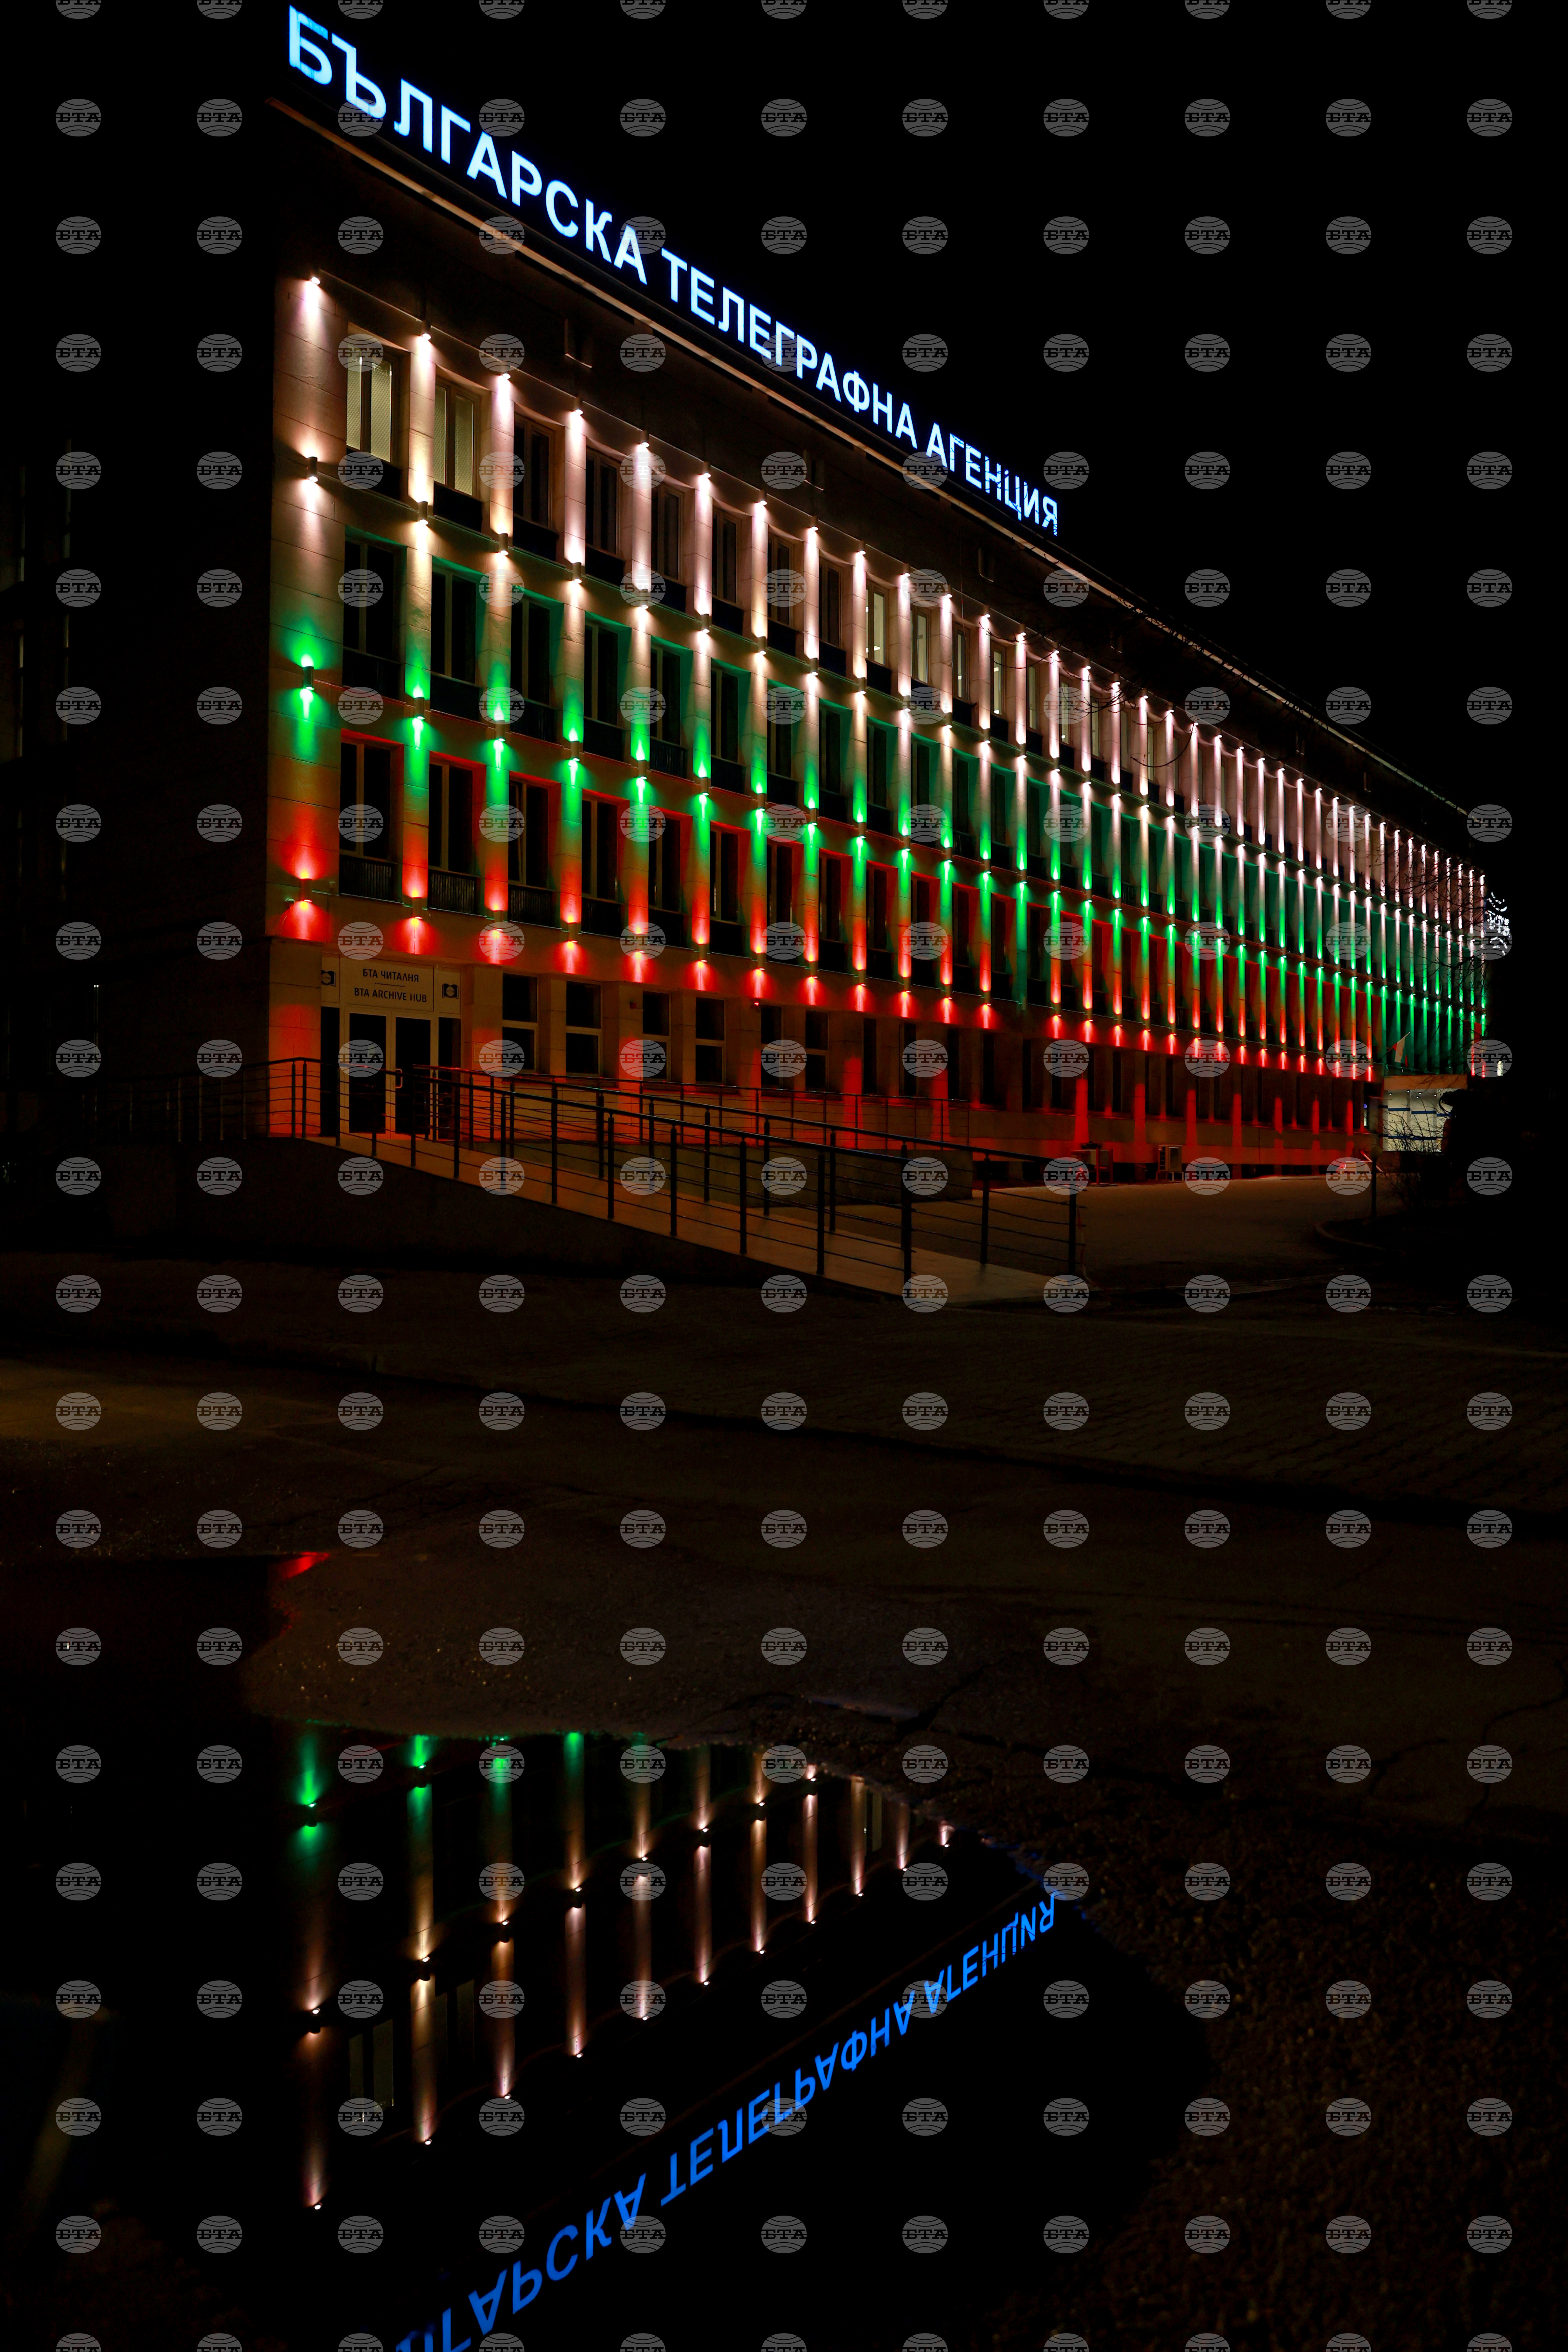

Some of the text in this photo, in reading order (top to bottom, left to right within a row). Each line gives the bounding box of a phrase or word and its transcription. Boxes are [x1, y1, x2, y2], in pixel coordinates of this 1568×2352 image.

[289, 5, 1058, 536] БЪЛГАРСКА ТЕЛЕГРАФНА АГЕНЦИЯ
[363, 969, 419, 982] БТА ЧИТАЛНЯ
[354, 987, 427, 1002] BTA ARCHIVE HUB
